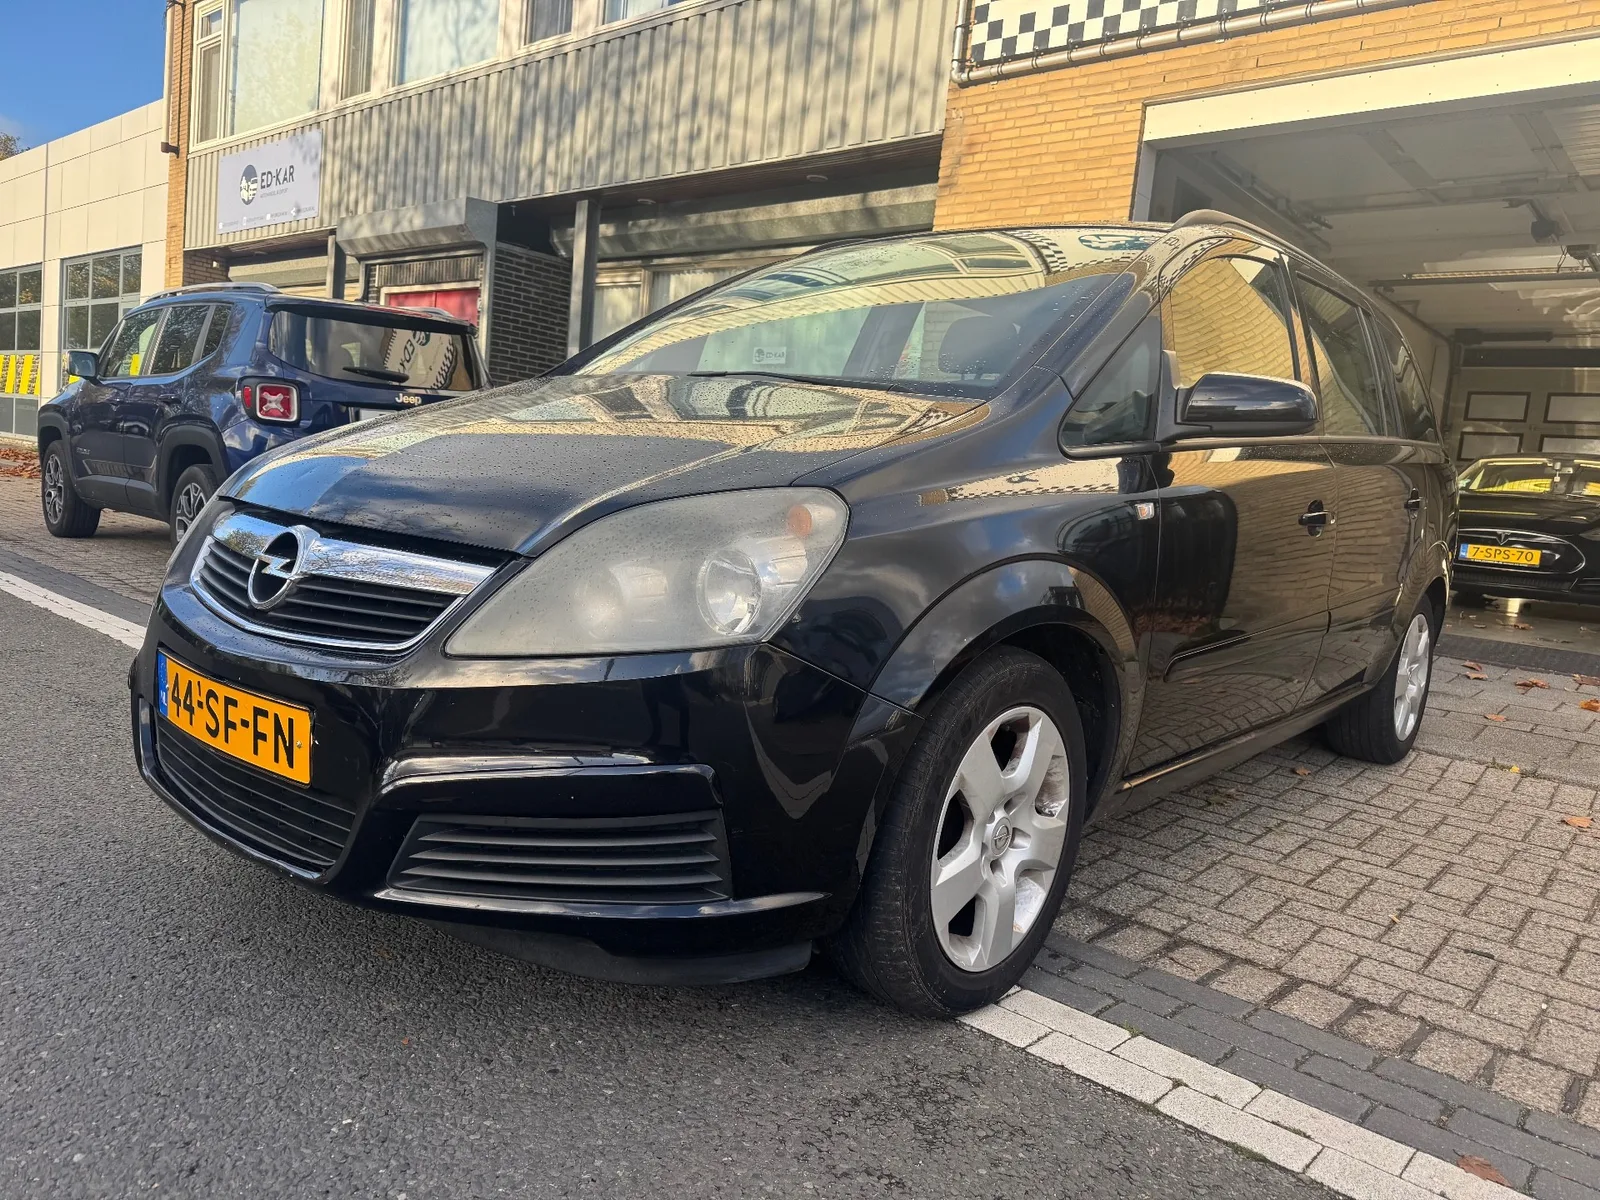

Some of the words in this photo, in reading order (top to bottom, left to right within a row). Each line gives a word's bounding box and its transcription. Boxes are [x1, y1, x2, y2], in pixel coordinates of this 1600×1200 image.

[260, 165, 294, 189] ED-KAR
[395, 393, 422, 405] Jeep
[1472, 547, 1534, 562] 7-SPS-70
[171, 672, 294, 769] 44-SF-FN
